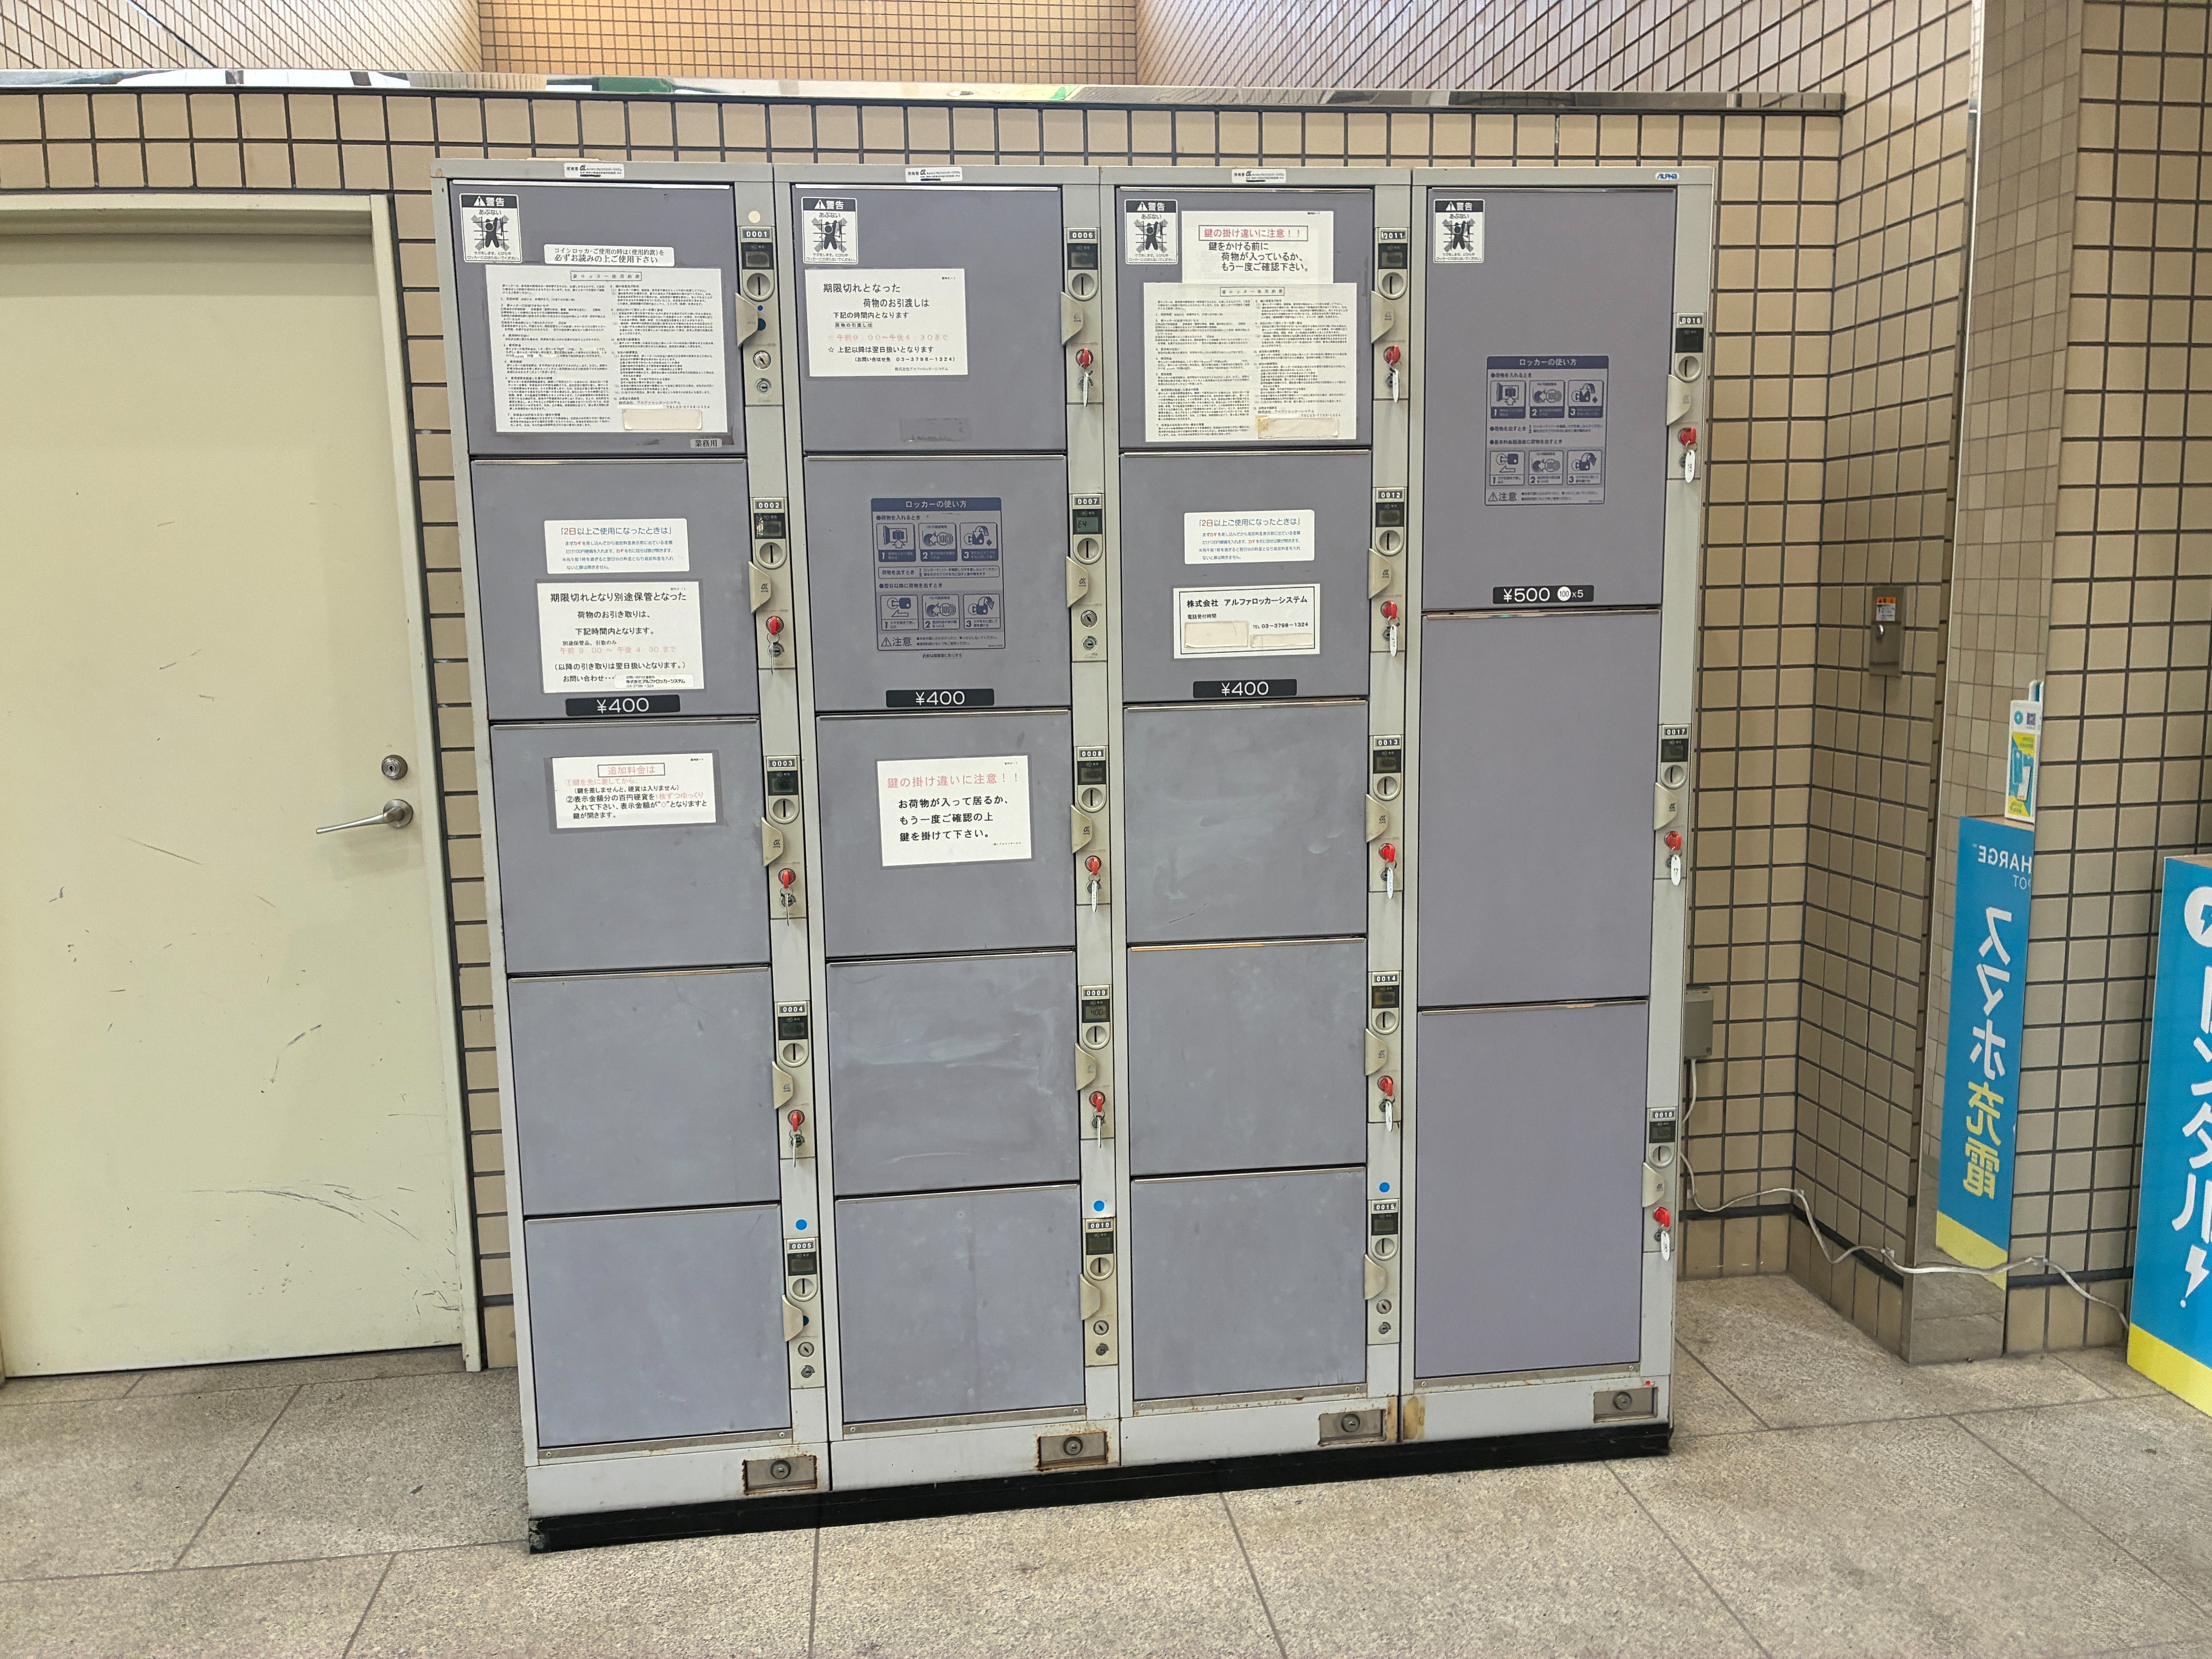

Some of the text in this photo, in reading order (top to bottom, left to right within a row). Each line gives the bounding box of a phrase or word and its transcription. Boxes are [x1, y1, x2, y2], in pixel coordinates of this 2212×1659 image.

[826, 201, 844, 210] 警告
[1148, 202, 1165, 211] 警告
[1209, 242, 1269, 251] 鍵をかける前に
[555, 254, 658, 263] 必ずお読みの上ご使用下さい
[1221, 252, 1303, 262] 荷物が入っているか、
[1221, 262, 1309, 272] もう一度ご確認下さい。
[823, 283, 901, 293] 期限切れとなった
[864, 298, 930, 308] 荷物のお引渡しは
[551, 592, 687, 603] 期限切れとなり別途保管となった
[1503, 587, 1550, 603] ¥500
[1187, 596, 1307, 608] 株式会社 アルファロッカーシステム
[577, 611, 650, 619] 荷物のお引き取りは、
[575, 627, 654, 635] 下記時間内となります。
[893, 637, 912, 646] 注意
[1221, 681, 1269, 696] ¥400
[915, 690, 965, 706] ¥400
[597, 697, 649, 714] ¥400
[608, 766, 655, 775] 追加料金は
[898, 795, 1007, 809] お荷物が入って居るか、
[900, 812, 993, 825] もう一度ご確認の上
[900, 830, 988, 842] 鍵を掛けて下さい。
